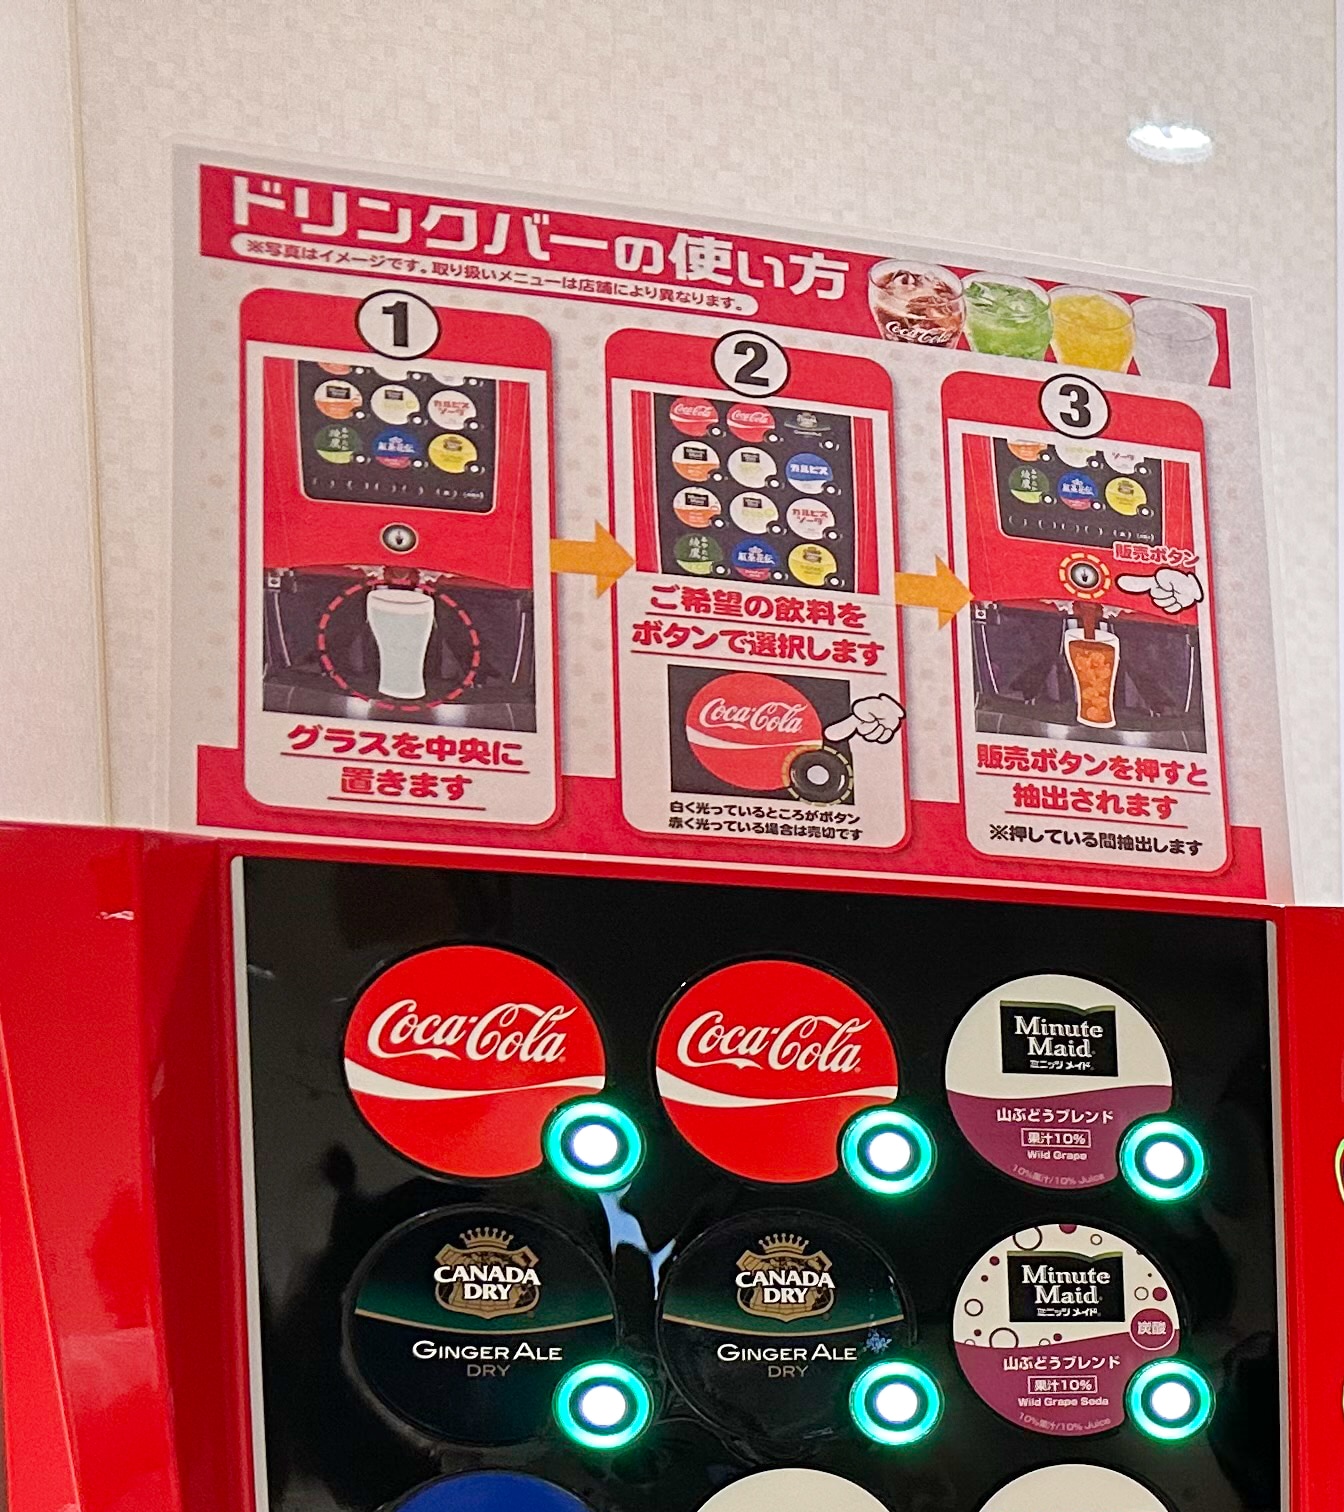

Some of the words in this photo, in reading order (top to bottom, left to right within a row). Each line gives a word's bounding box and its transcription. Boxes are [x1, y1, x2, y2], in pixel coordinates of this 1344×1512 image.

[232, 174, 850, 301] ドリンクバーの使い方
[382, 301, 409, 348] 1
[733, 340, 770, 388] 2
[1058, 383, 1091, 428] 3
[1115, 544, 1200, 566] 販売ボタン
[650, 584, 867, 628] ご希望の飲料を
[632, 619, 885, 666] ボタンで選択します
[698, 696, 803, 735] Coca-Cola
[287, 723, 524, 767] グラスを中央に
[977, 744, 1208, 787] 販売ボタンを押すと
[340, 767, 472, 801] 置きます
[1013, 783, 1178, 820] 抽出されます
[669, 801, 860, 825] 白く光っているところがボタン
[668, 816, 864, 841] 赤く光っている場合は売切です
[367, 999, 577, 1062] Coca-Cola
[1014, 1015, 1104, 1038] Minute
[676, 1010, 872, 1073] Coca-Cola
[1027, 1036, 1093, 1058] Maid
[996, 1107, 1115, 1125] 山ぶどうブレンド
[1027, 1132, 1086, 1147] 果汁10%
[1027, 1150, 1050, 1160] Wild
[1053, 1151, 1088, 1161] Grape
[433, 1265, 541, 1286] CANADA
[735, 1271, 836, 1289] CANADA
[1021, 1265, 1111, 1285] Minute
[464, 1284, 512, 1300] DRY
[763, 1288, 809, 1304] DRY
[1034, 1285, 1099, 1304] Maid
[466, 1364, 511, 1377] DRY
[767, 1365, 809, 1378] DRY
[1003, 1355, 1121, 1371] 山ぶどうブレンド
[1034, 1380, 1092, 1392] 果汁10%
[1018, 1397, 1042, 1407] Wild
[1044, 1397, 1078, 1407] Grape
[1080, 1397, 1109, 1406] Soda
